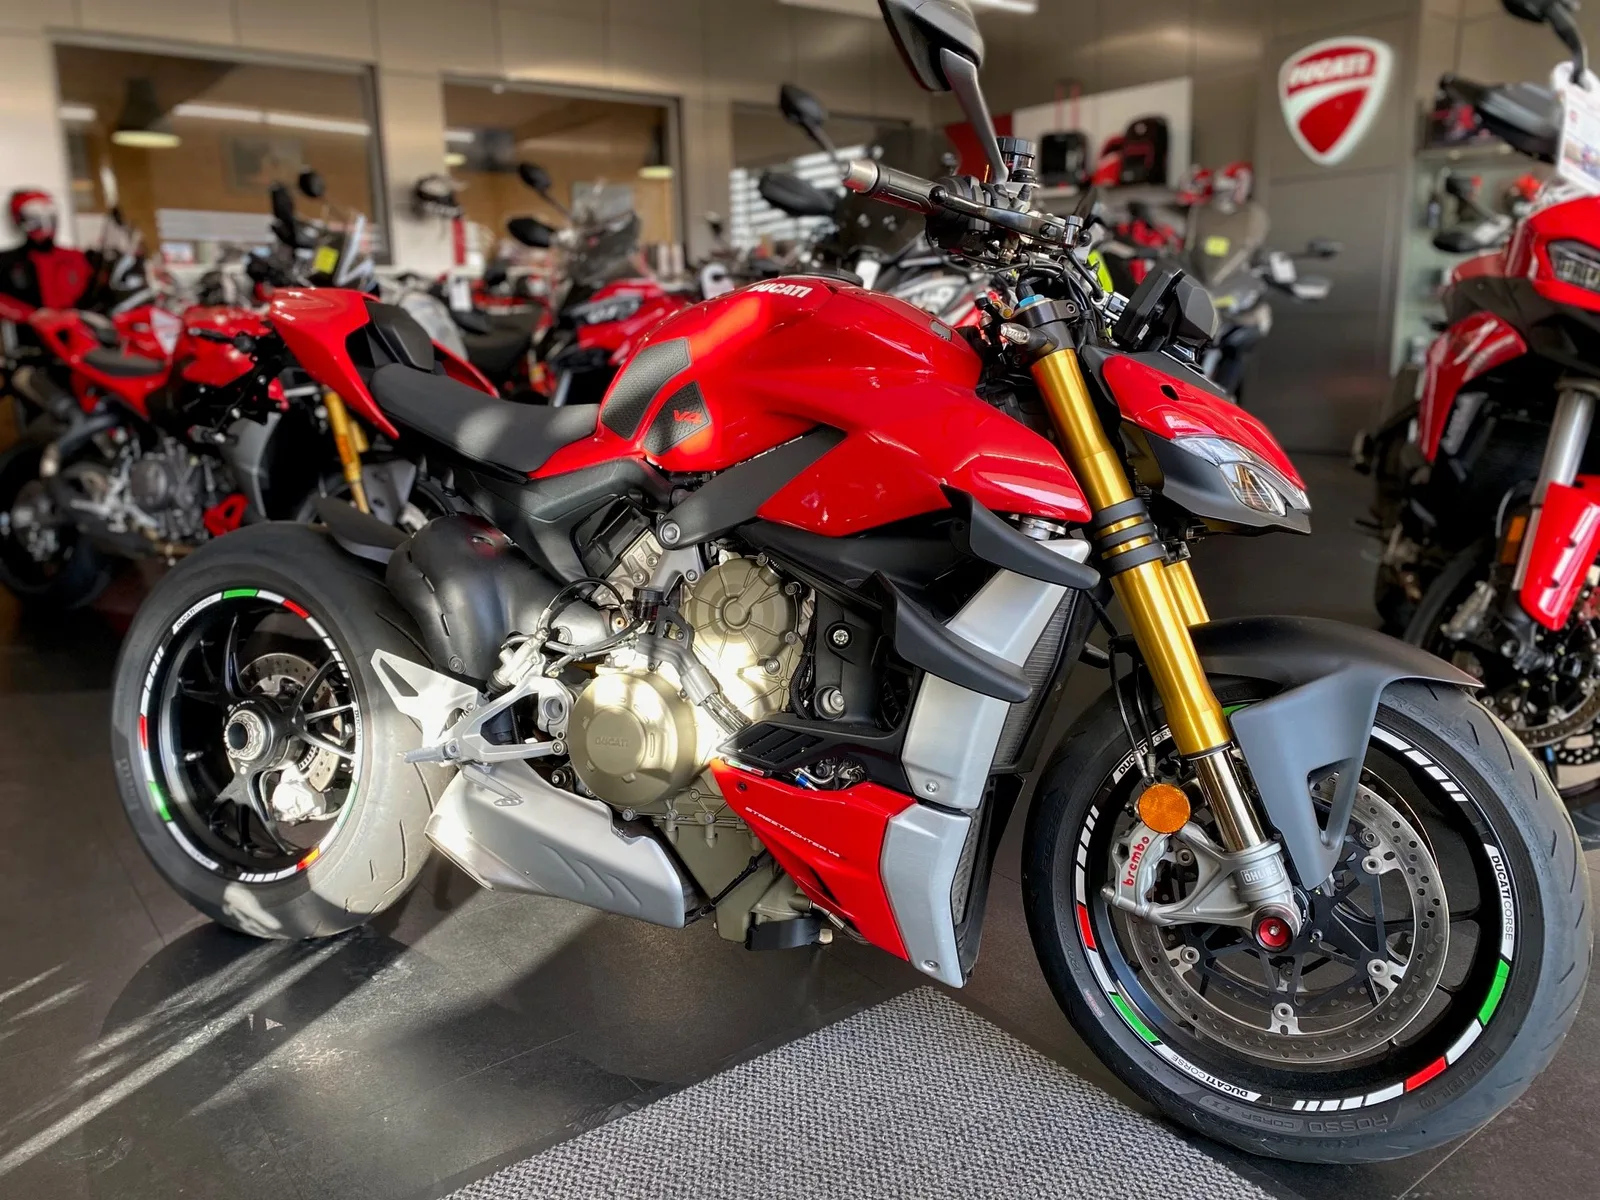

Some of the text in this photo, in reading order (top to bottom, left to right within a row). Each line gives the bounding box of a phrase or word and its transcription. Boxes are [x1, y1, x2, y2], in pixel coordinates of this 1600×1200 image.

[1286, 52, 1370, 86] DUCATI
[747, 282, 814, 299] DUCATI
[744, 806, 827, 851] STREETFIGHTER
[1122, 836, 1150, 887] brembo
[1491, 855, 1514, 941] DUCATI CORSE
[1171, 1054, 1249, 1098] DUCATI CORSE
[1308, 1113, 1389, 1134] ROSSO
